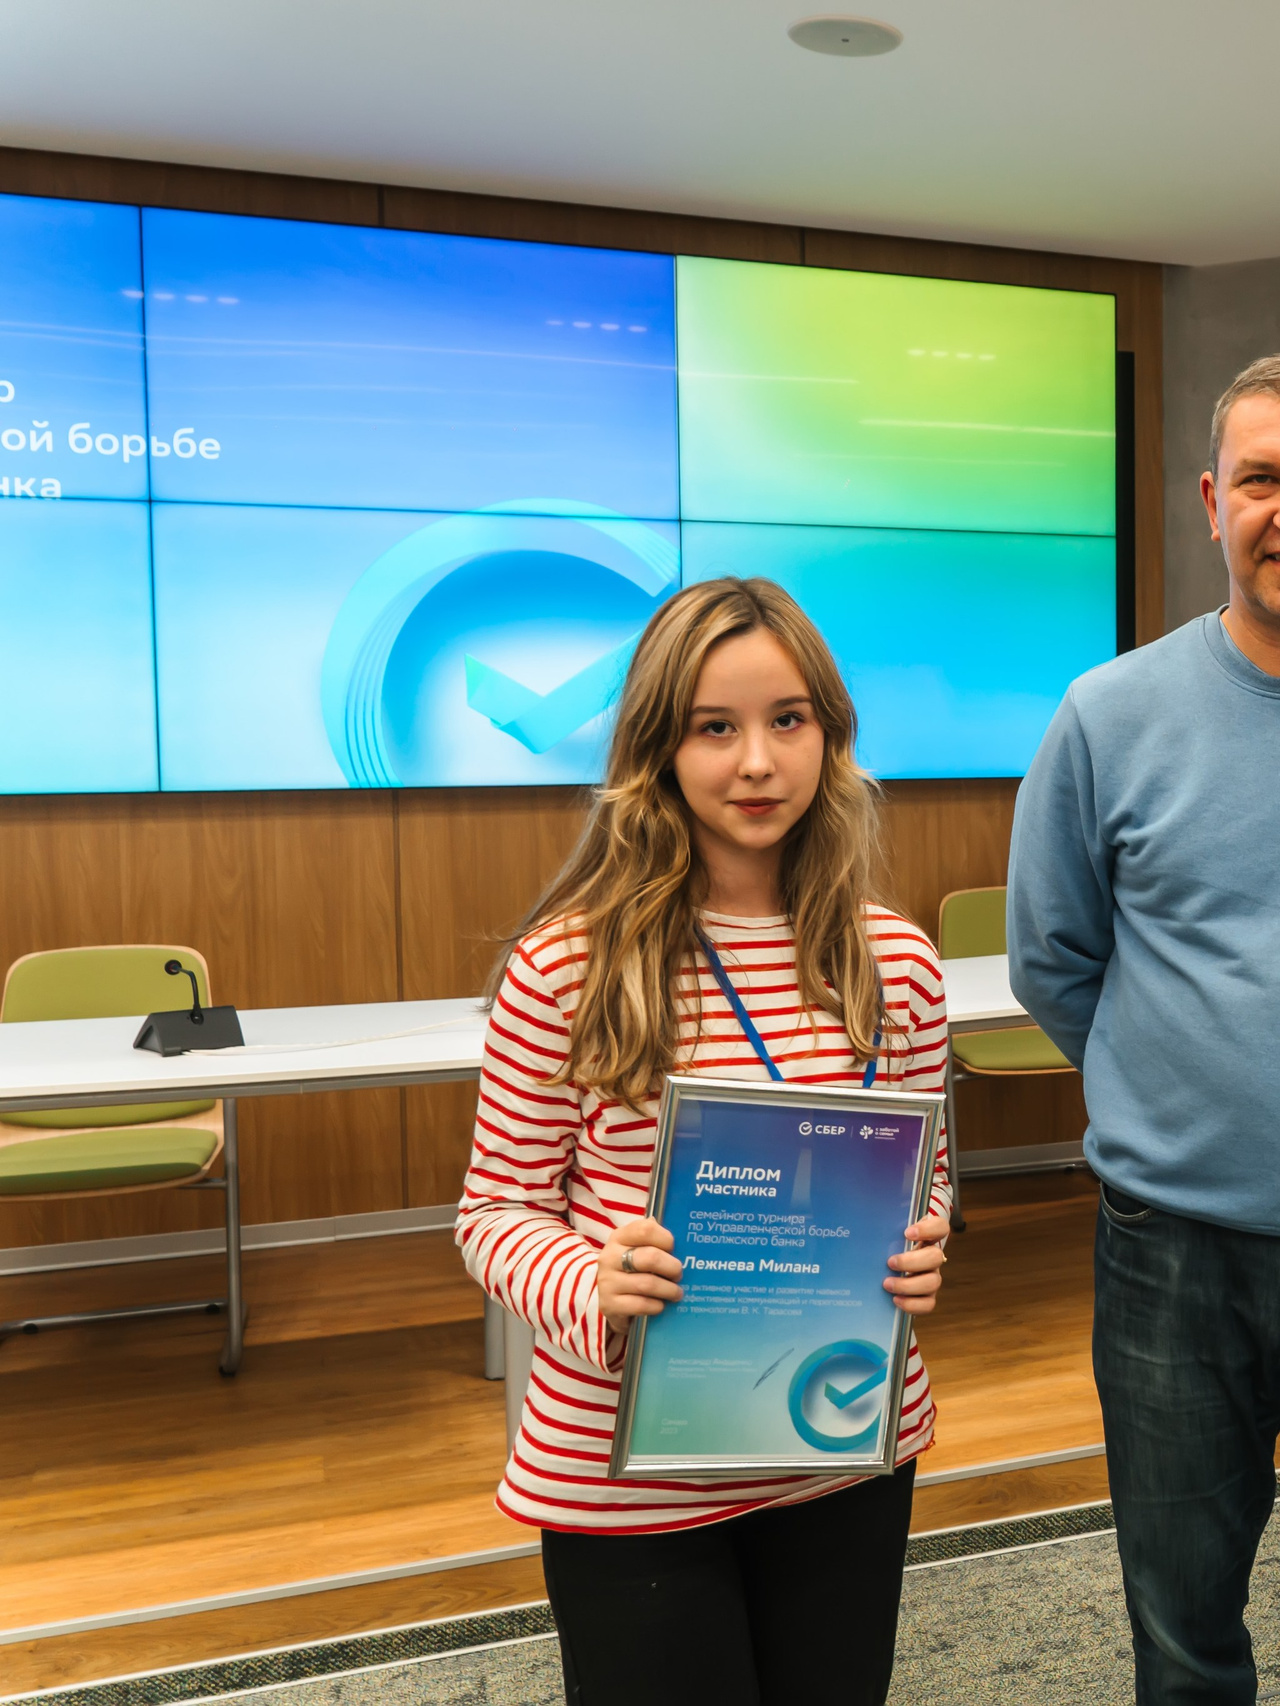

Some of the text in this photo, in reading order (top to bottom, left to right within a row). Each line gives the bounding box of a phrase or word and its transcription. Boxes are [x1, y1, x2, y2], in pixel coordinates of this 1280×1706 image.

[67, 422, 220, 462] борьбе
[815, 1125, 846, 1136] СБЕР
[695, 1160, 781, 1181] Диплом
[695, 1183, 777, 1197] участника
[689, 1209, 806, 1225] семейного турнира
[688, 1221, 850, 1238] по Управленческой борьбе
[686, 1232, 806, 1247] Поволжского банка
[682, 1256, 821, 1274] Лежнева Милана
